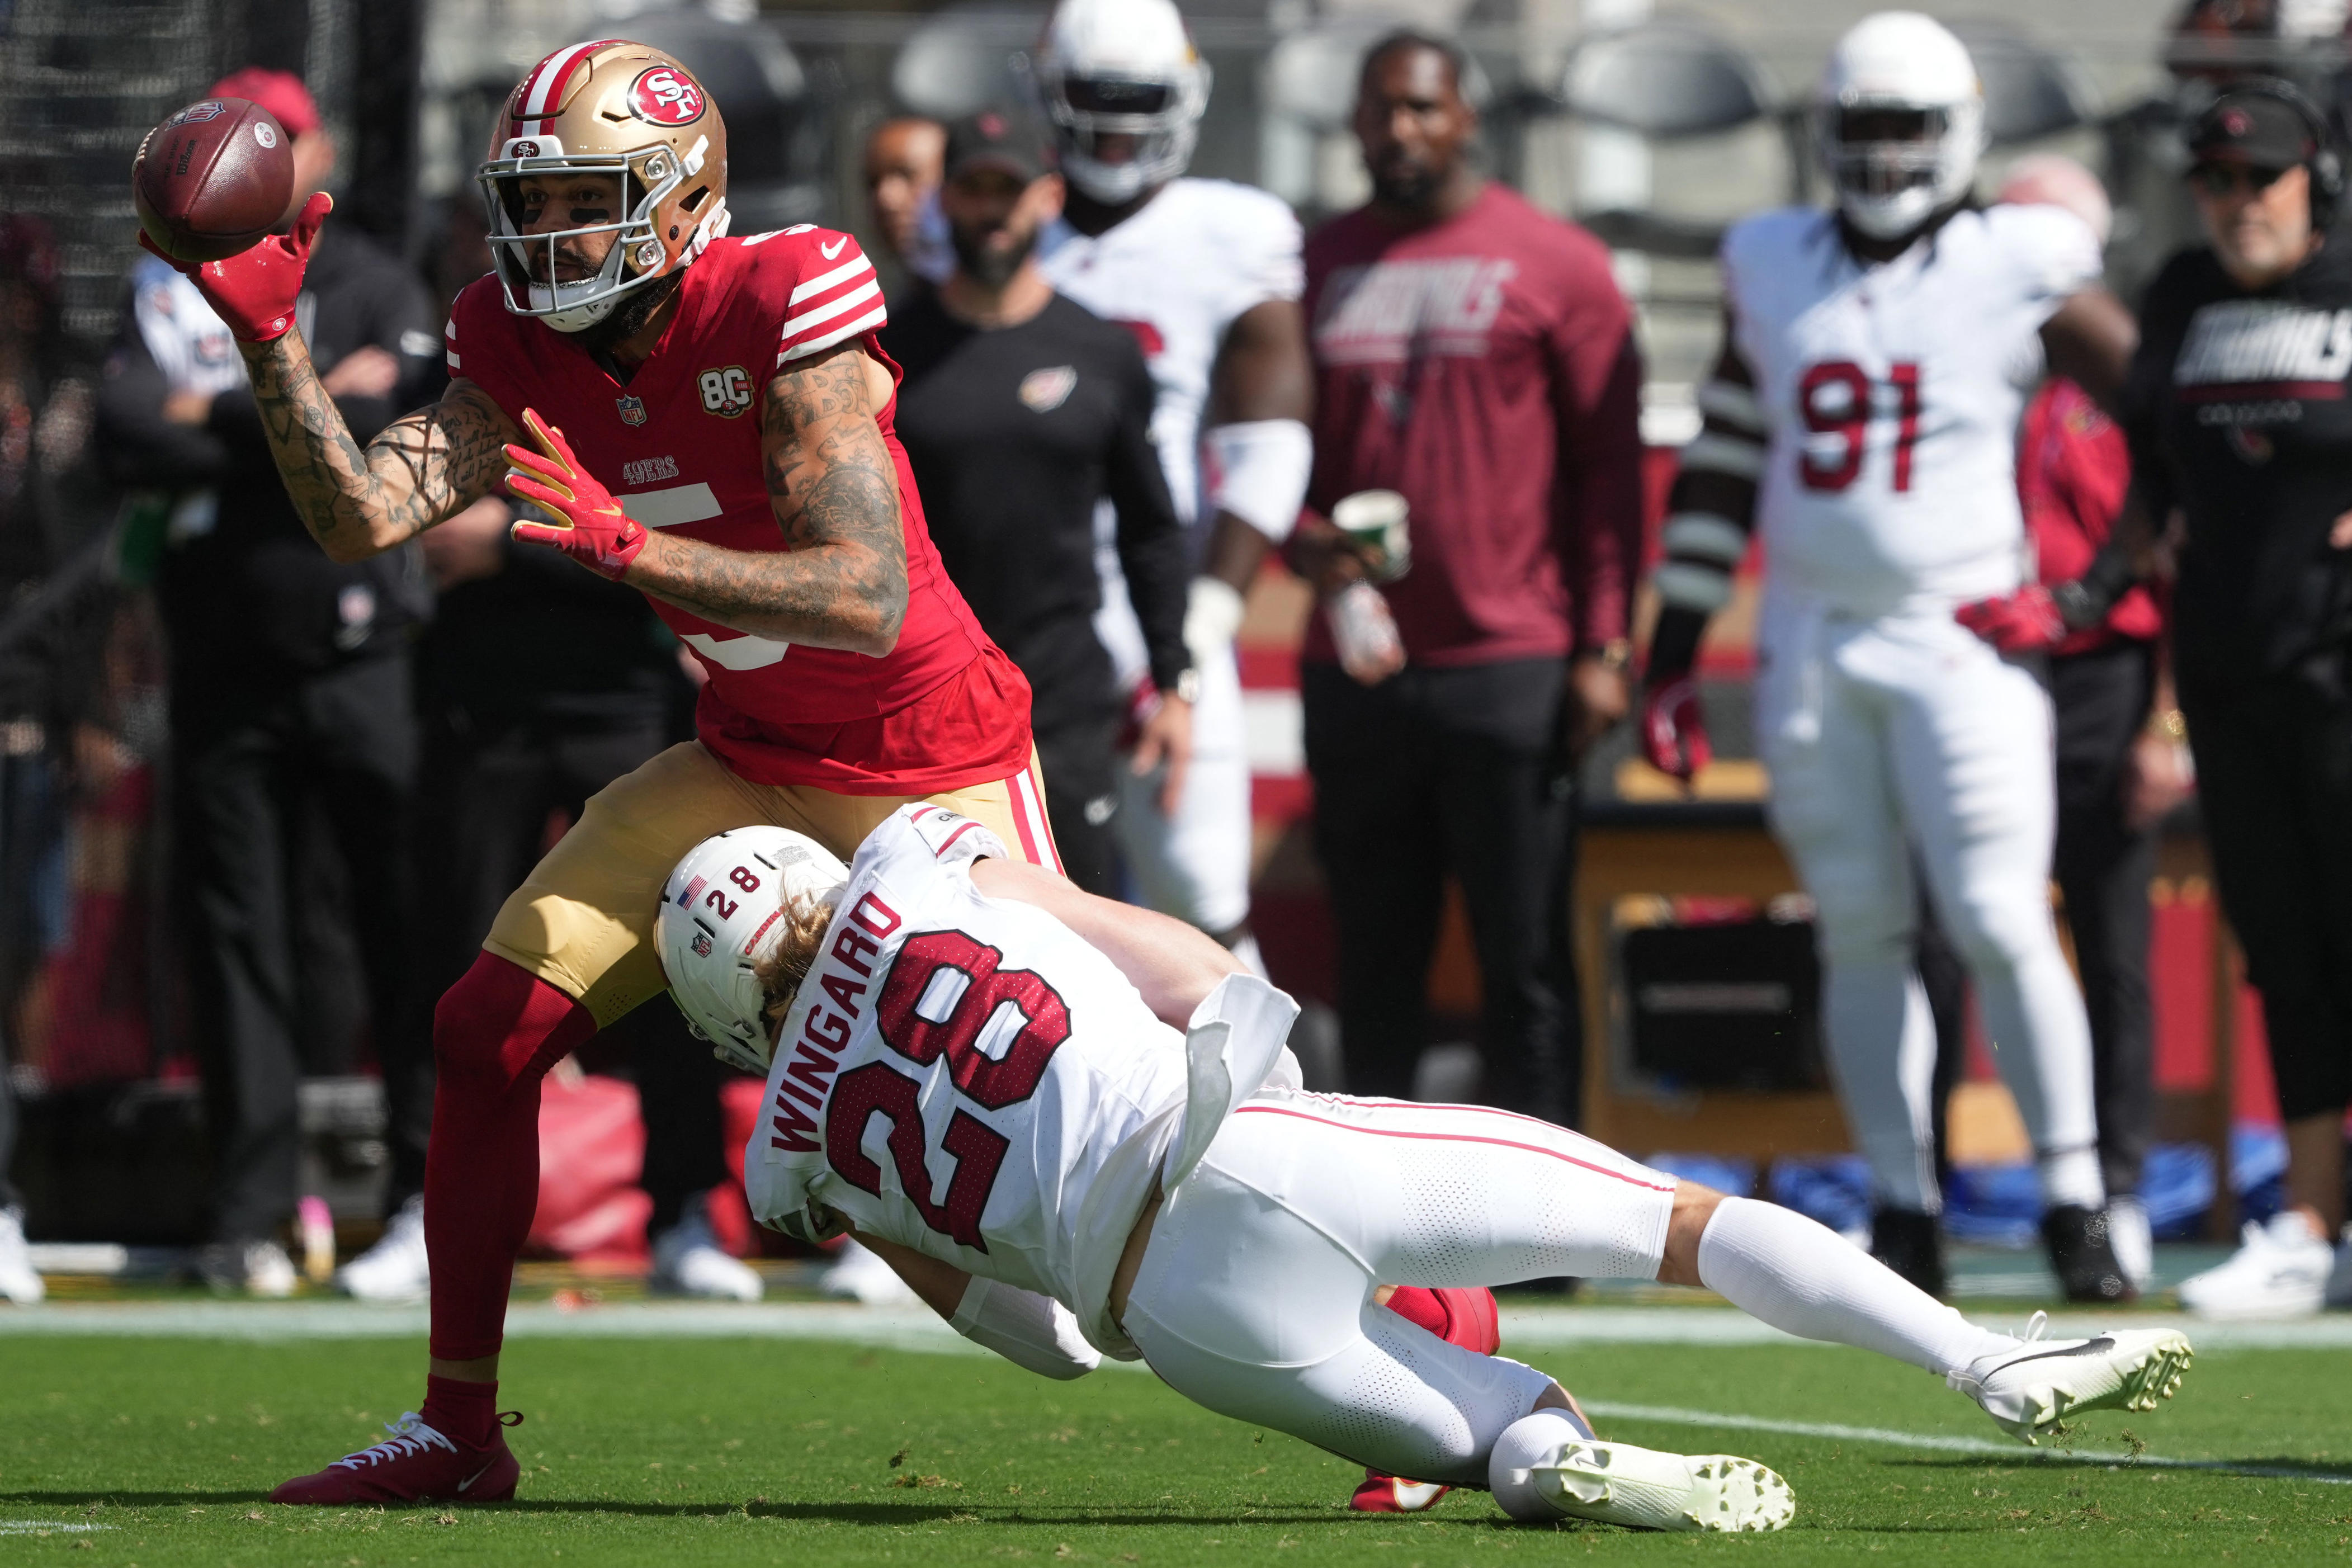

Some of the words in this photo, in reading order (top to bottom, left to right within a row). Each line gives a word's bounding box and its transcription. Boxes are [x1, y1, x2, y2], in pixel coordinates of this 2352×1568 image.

[647, 71, 697, 119] SF
[176, 139, 197, 176] Wilson
[518, 143, 534, 157] SF
[624, 409, 643, 422] NFL
[1799, 361, 1917, 492] 91
[623, 455, 679, 485] 49ERS
[706, 866, 761, 921] 28
[771, 890, 901, 1153] WINGARD
[826, 928, 1073, 1256] 28
